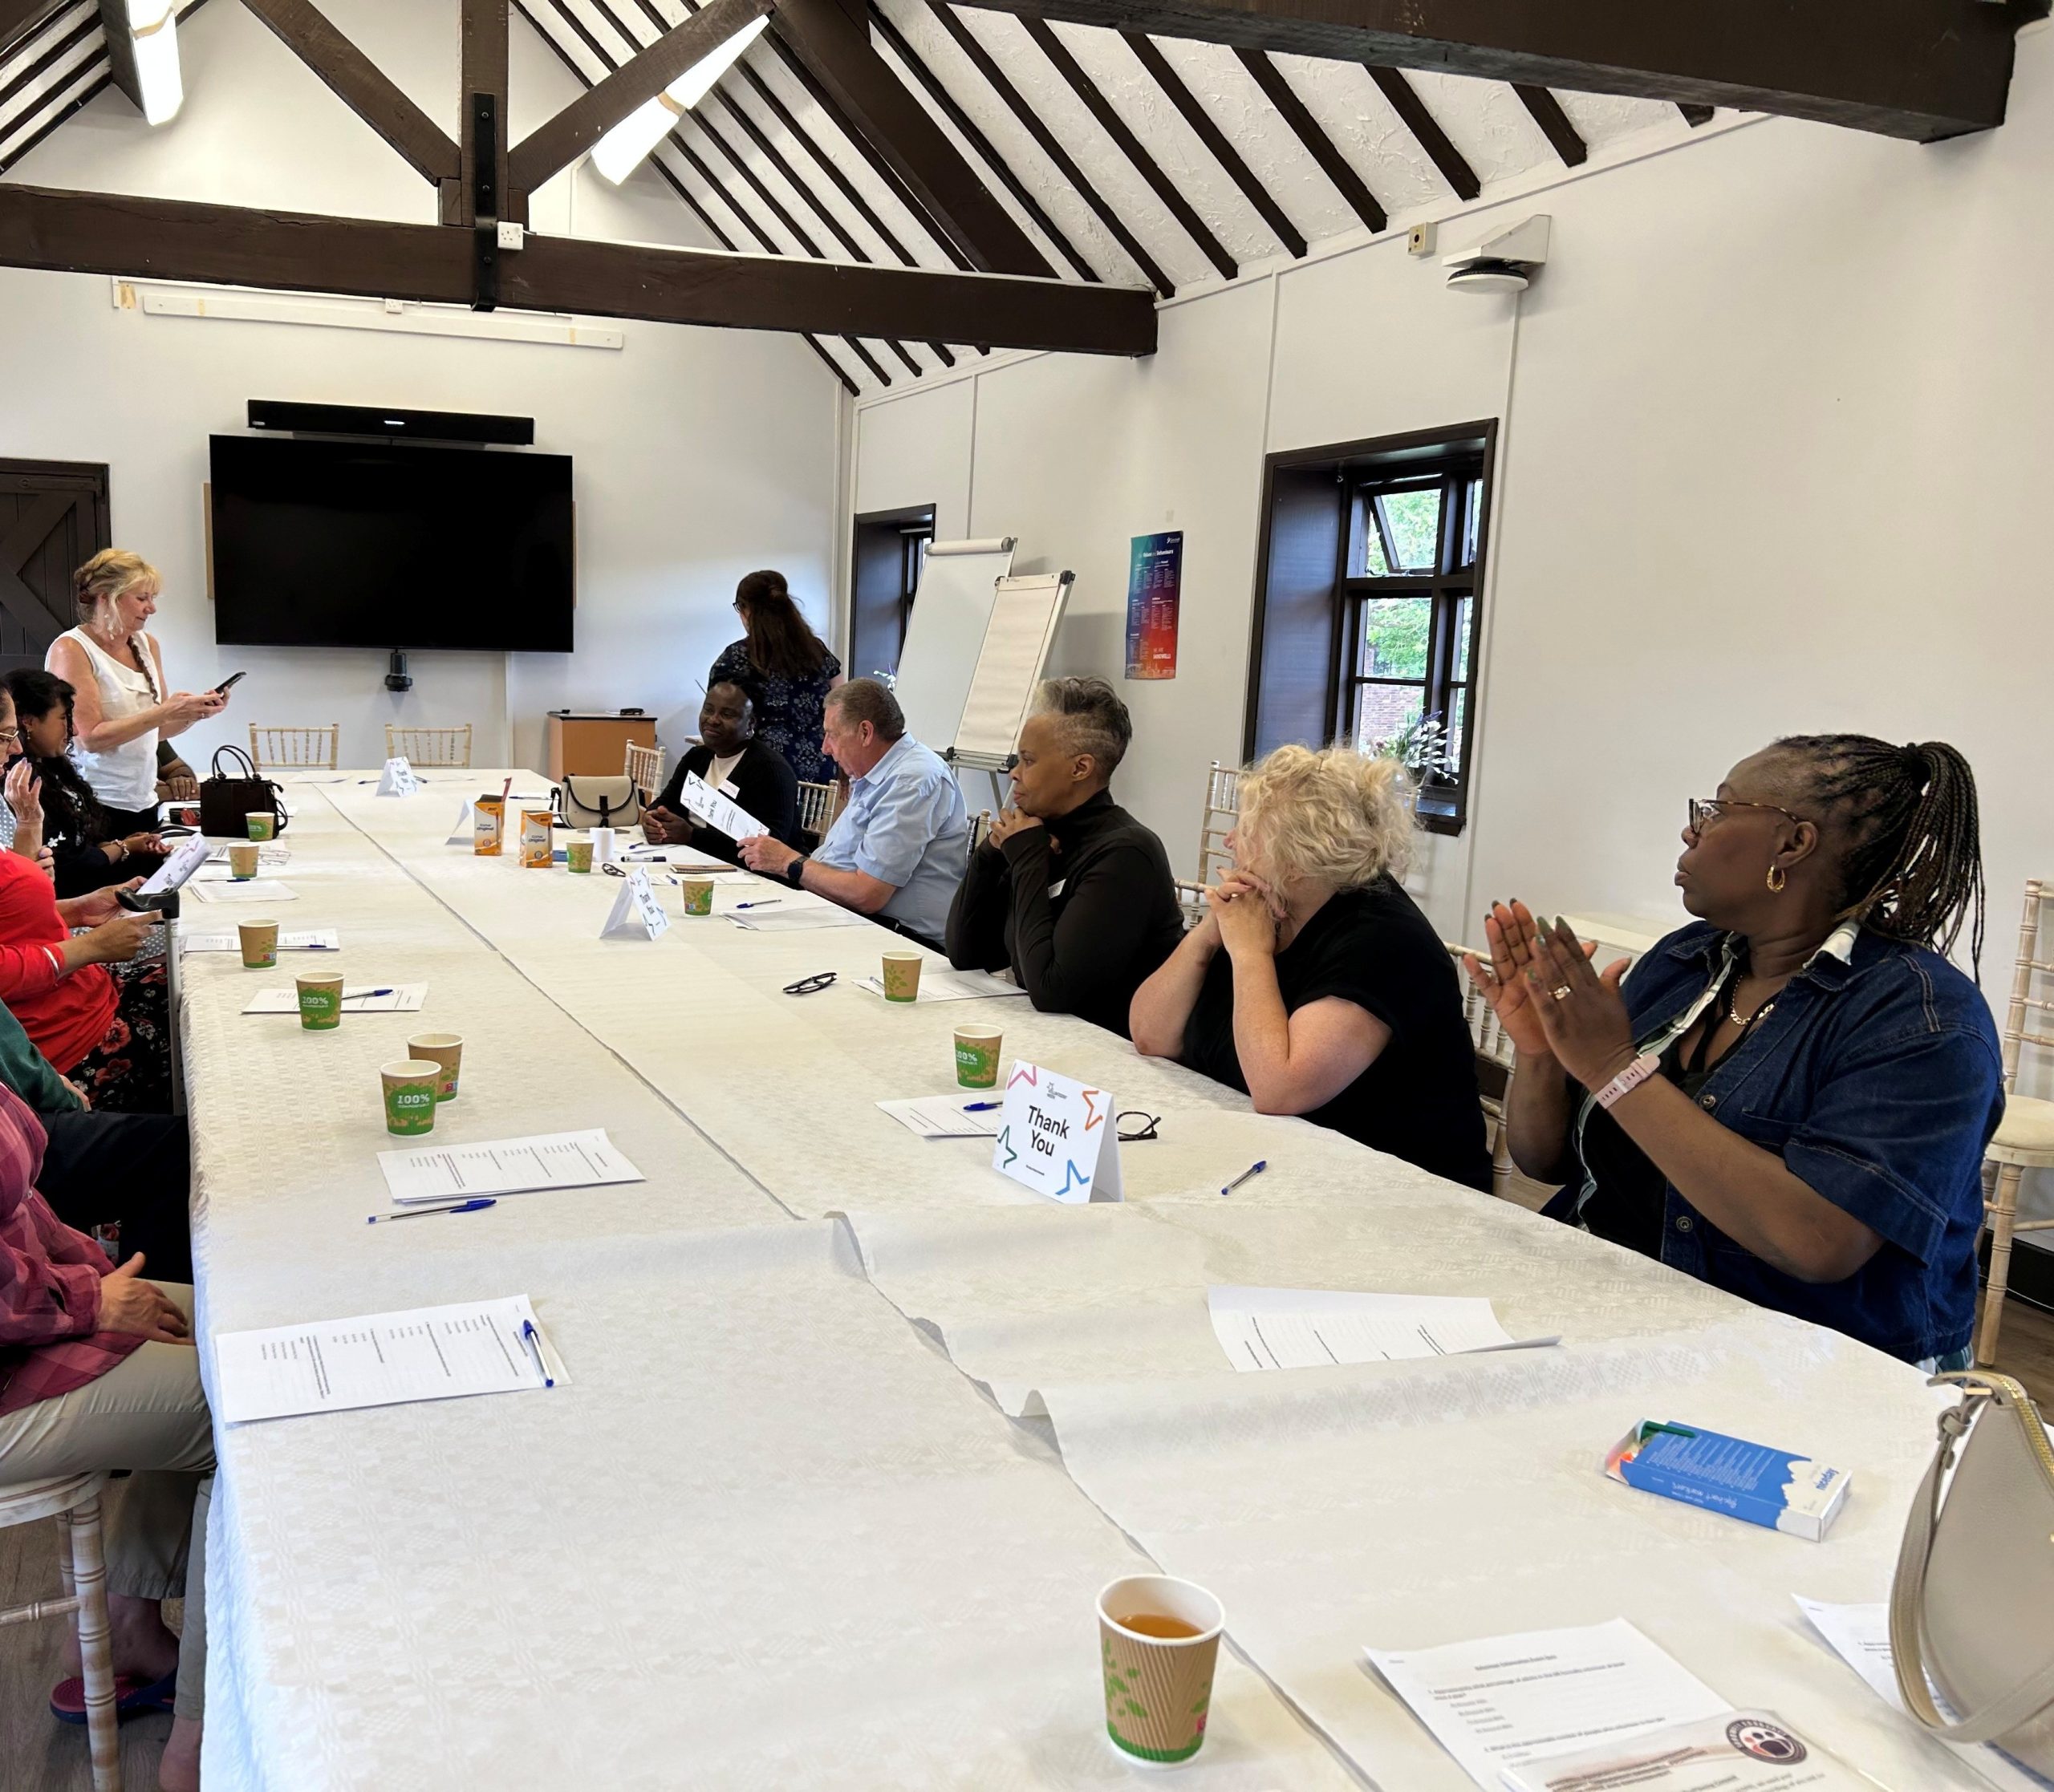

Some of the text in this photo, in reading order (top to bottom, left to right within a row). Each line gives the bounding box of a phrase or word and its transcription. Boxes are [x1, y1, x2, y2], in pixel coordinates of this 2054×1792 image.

[302, 996, 329, 1004] 100%
[397, 1093, 430, 1105] 100%
[1028, 1105, 1070, 1139] Thank
[1031, 1129, 1055, 1157] You
